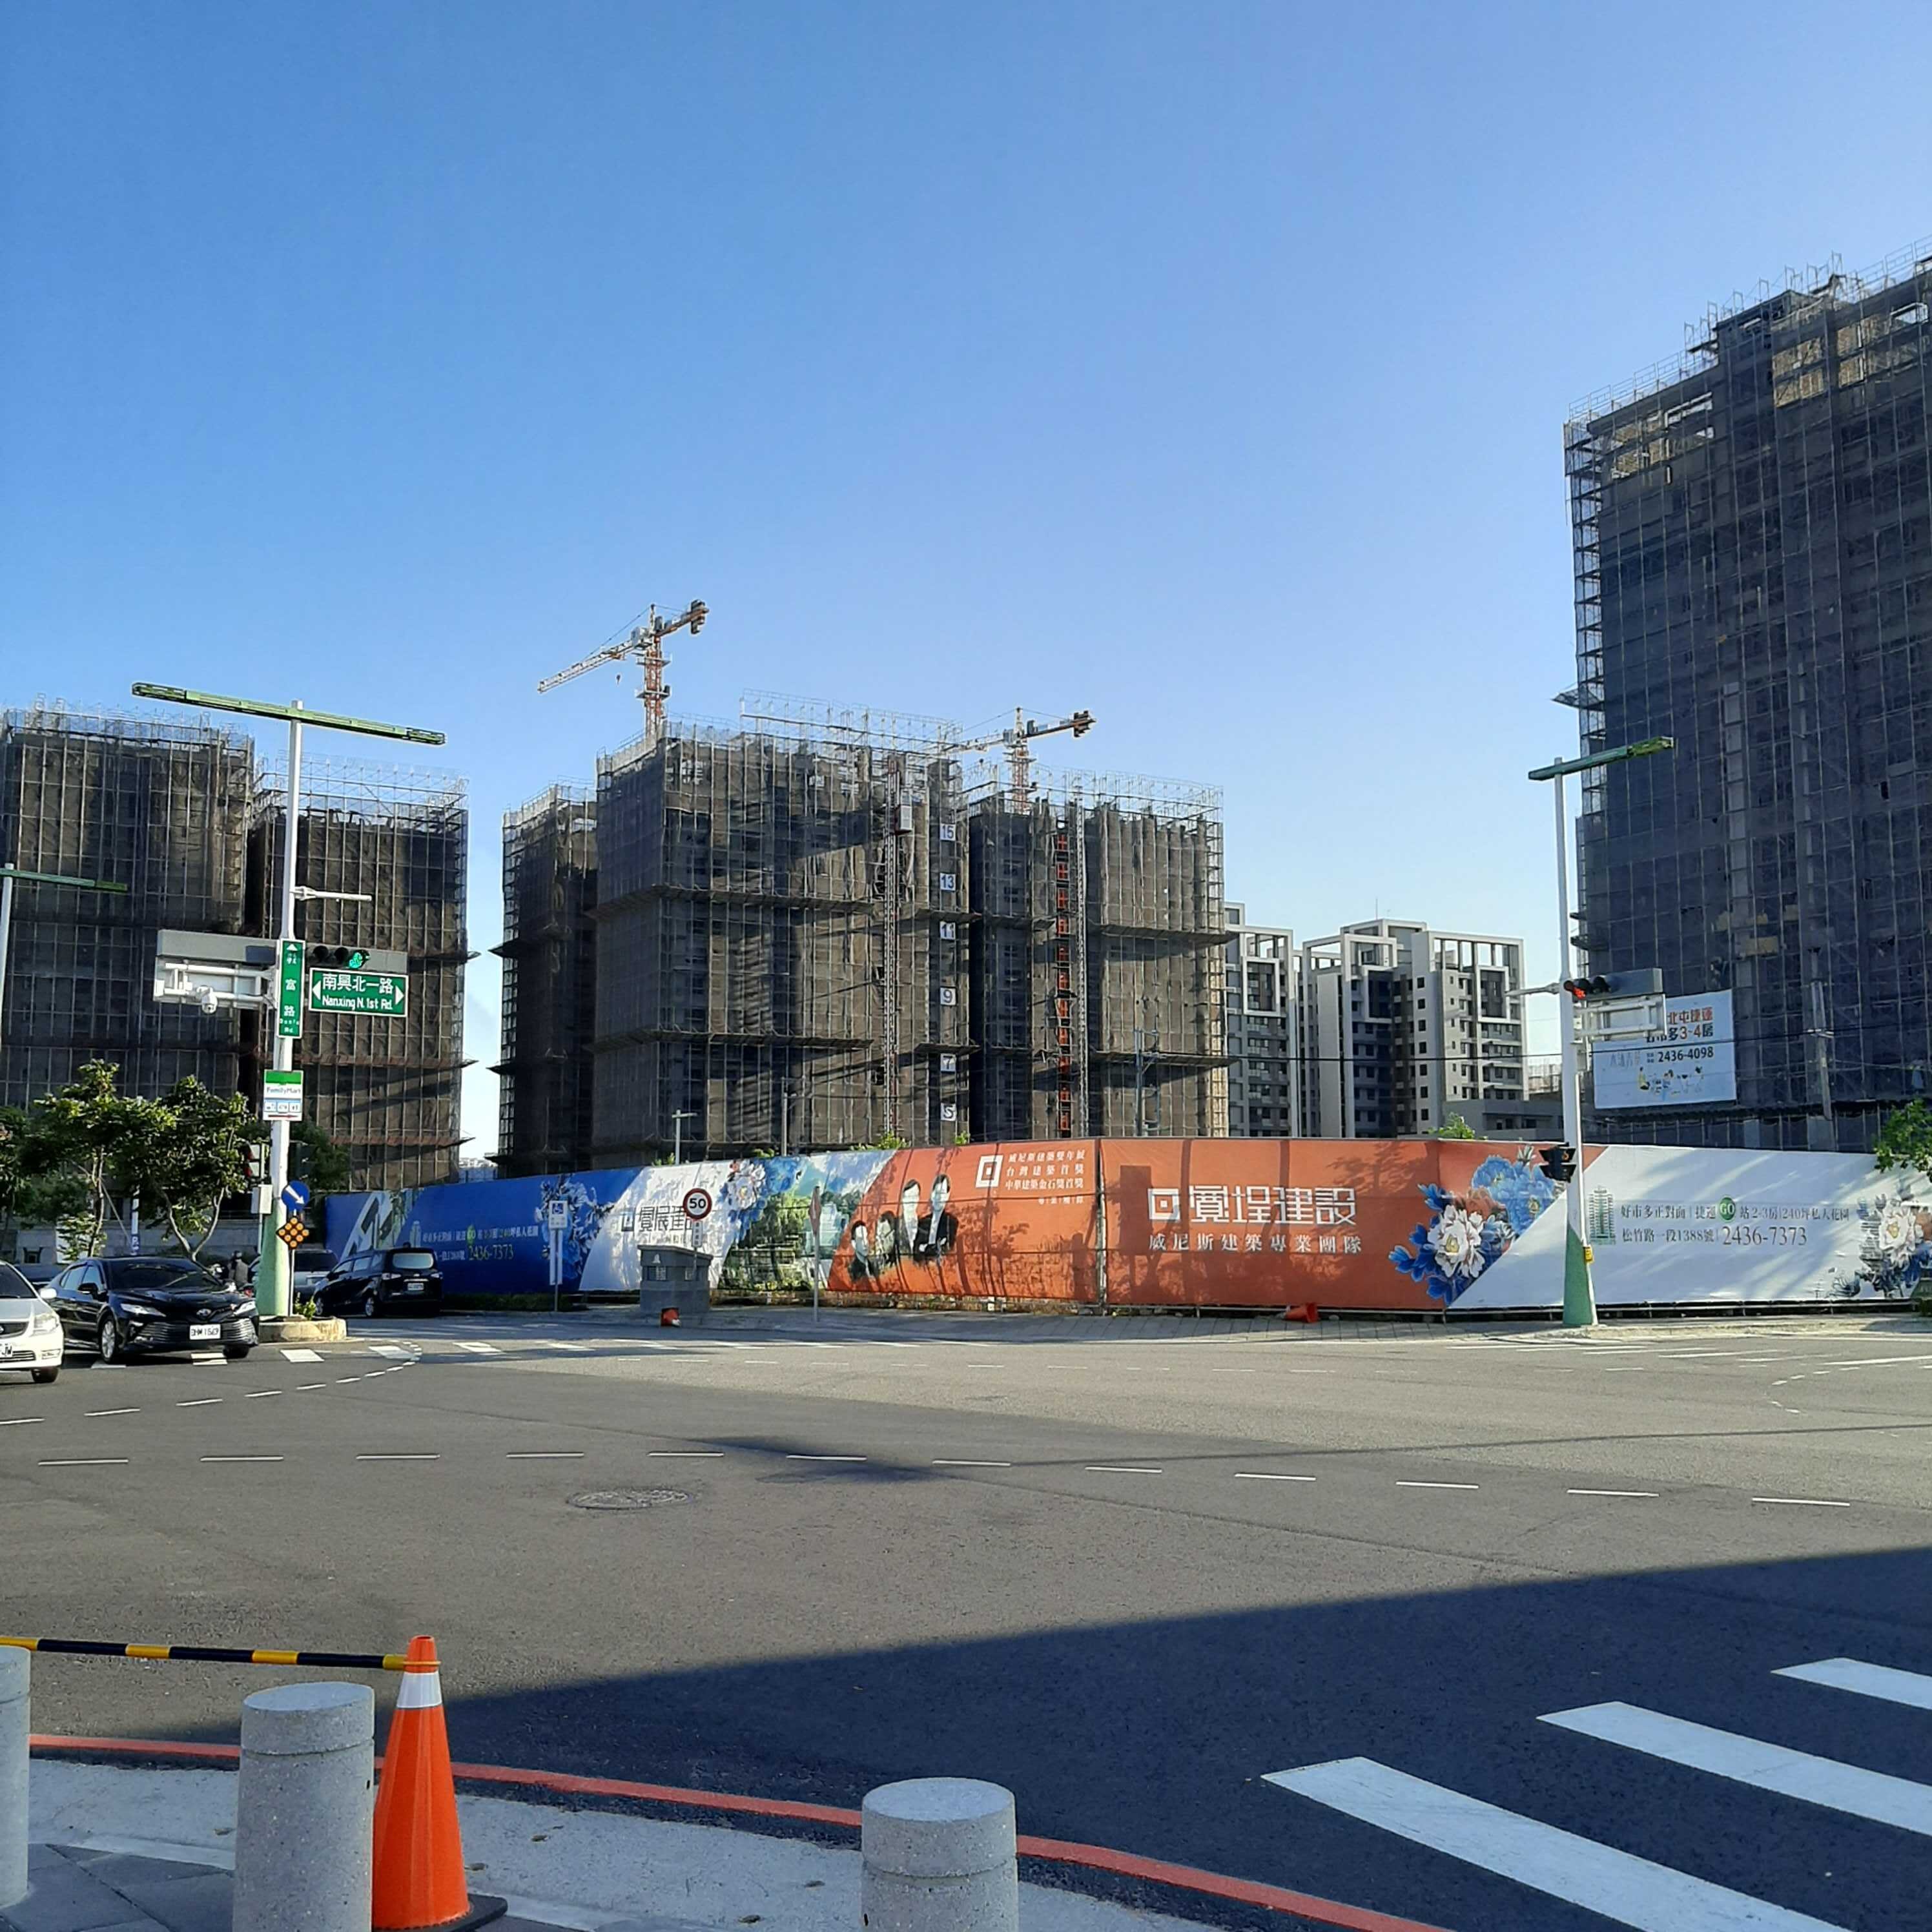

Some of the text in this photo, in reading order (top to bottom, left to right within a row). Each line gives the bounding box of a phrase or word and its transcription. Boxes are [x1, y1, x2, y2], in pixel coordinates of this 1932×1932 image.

[941, 875, 954, 889] 13
[941, 924, 954, 938] 11
[322, 973, 394, 994] 南興北一路
[322, 994, 356, 1010] Nanxing
[367, 998, 378, 1009] 1st
[943, 989, 952, 1003] 9
[1658, 1046, 1714, 1063] 2436-4098
[943, 1056, 953, 1069] 7
[943, 1105, 954, 1118] 5
[689, 1198, 706, 1209] 50
[1621, 1204, 1685, 1219] 好市多正對面
[1149, 1233, 1362, 1253] 威尼斯建築專業團隊
[1623, 1226, 1807, 1246] 松竹路一段1388號 2436-7373
[468, 1244, 514, 1261] 2436-7373
